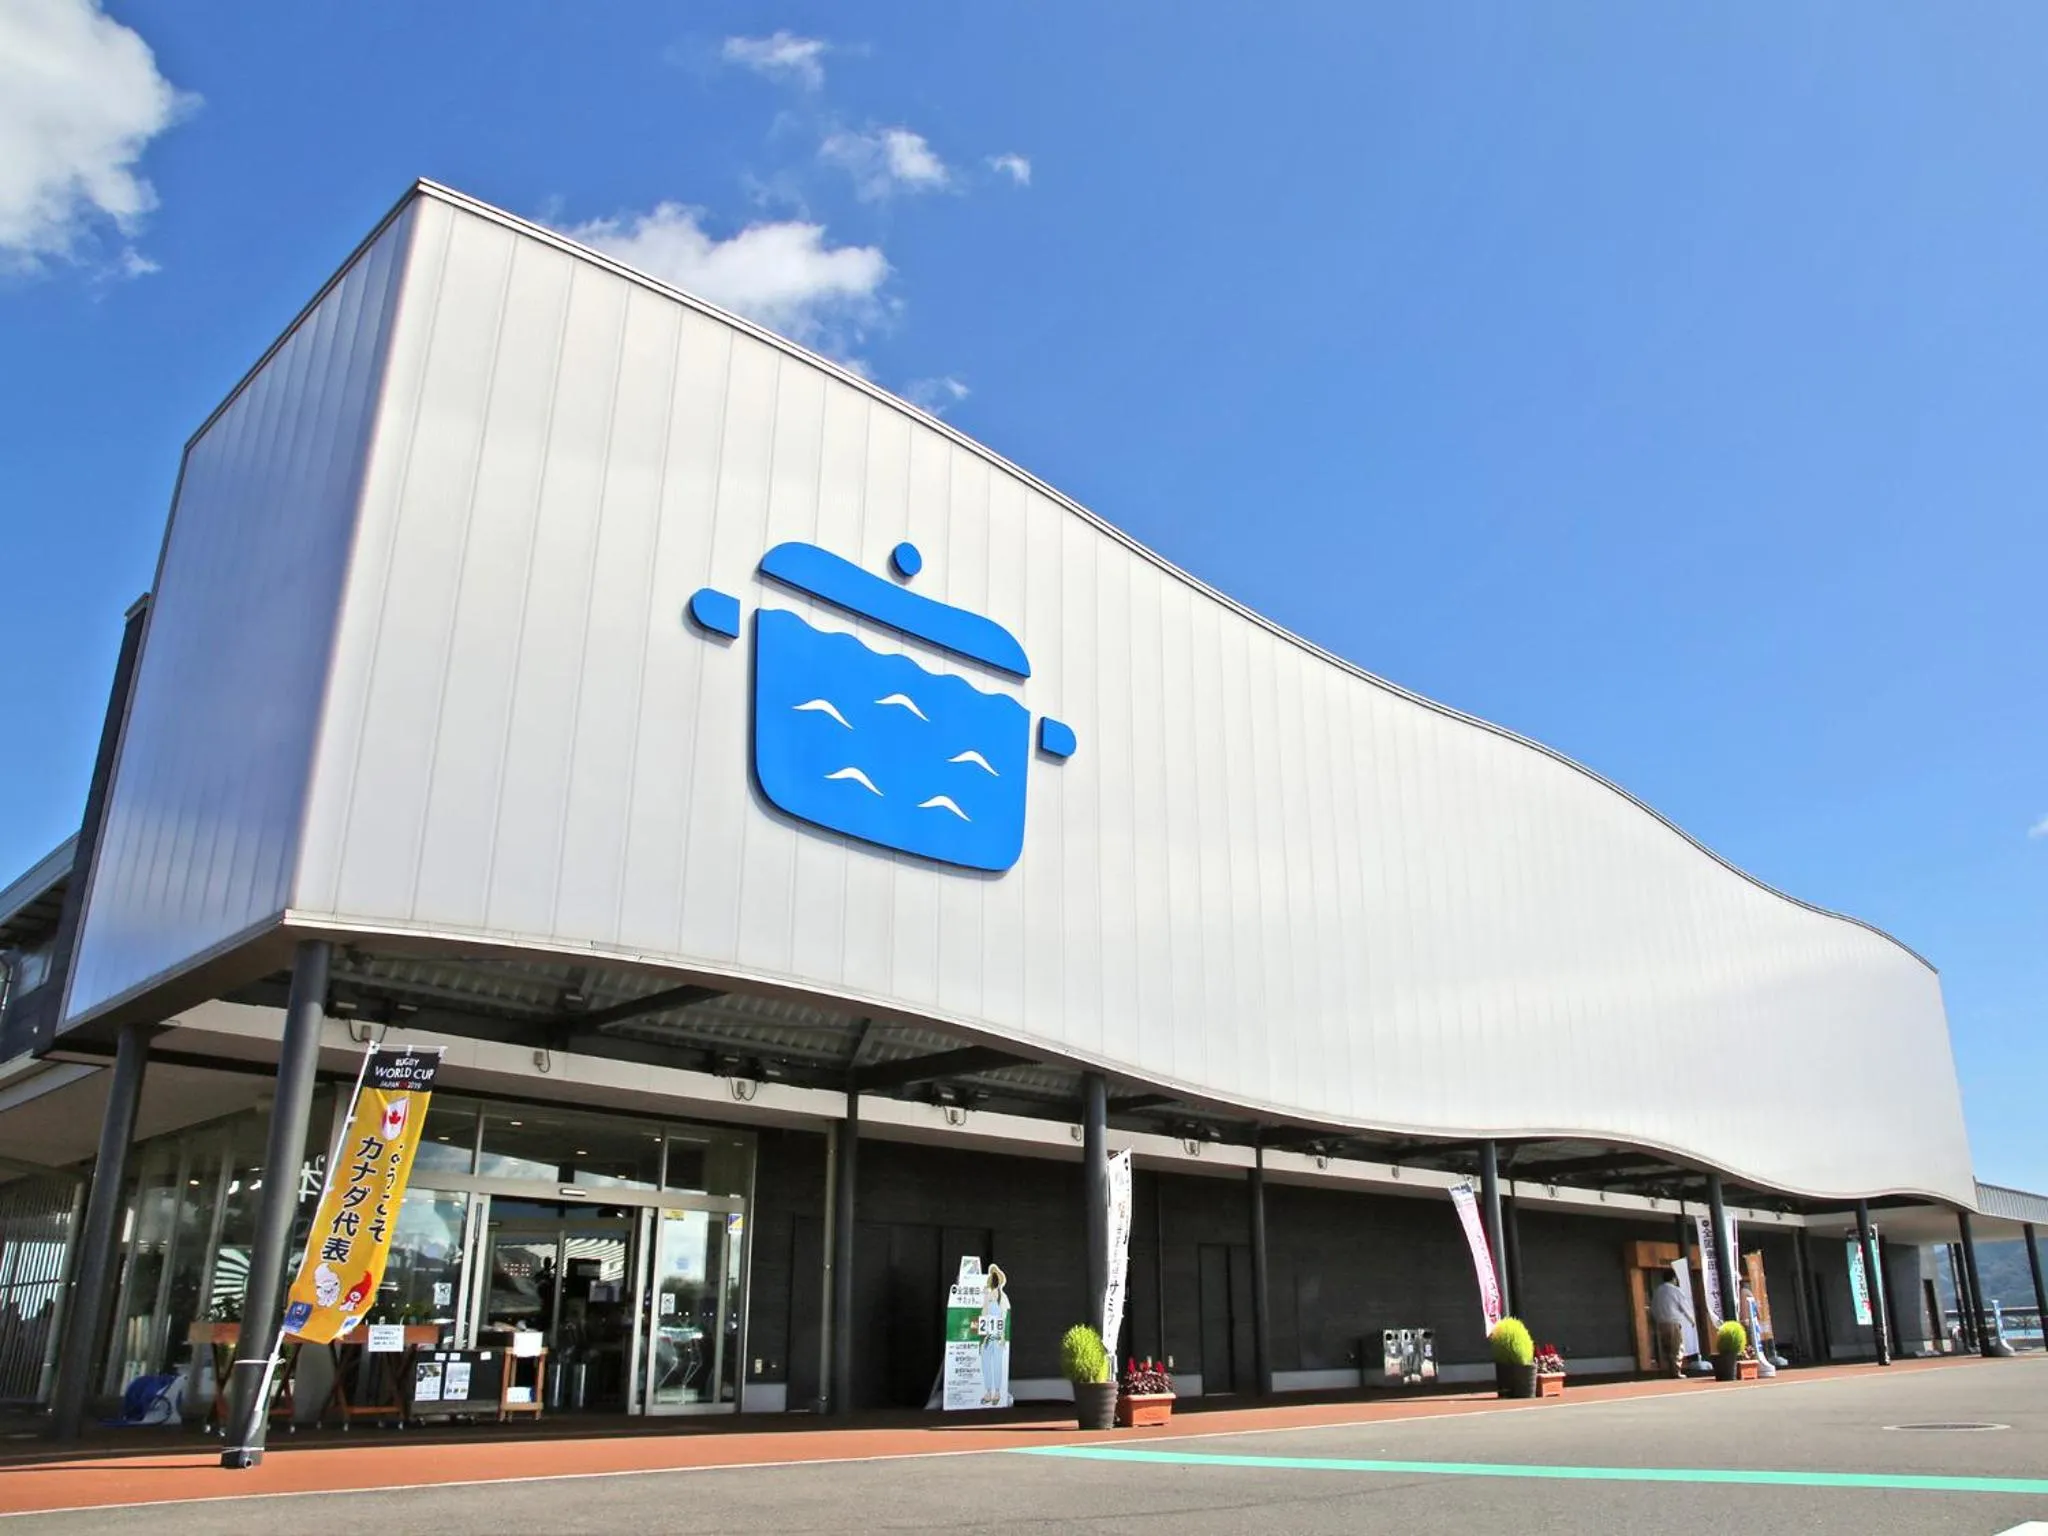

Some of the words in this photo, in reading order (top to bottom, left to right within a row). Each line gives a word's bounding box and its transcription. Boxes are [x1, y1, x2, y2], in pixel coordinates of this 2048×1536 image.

[375, 1066, 412, 1079] WORLD
[413, 1068, 435, 1080] CUP
[322, 1136, 384, 1263] カナダ代表
